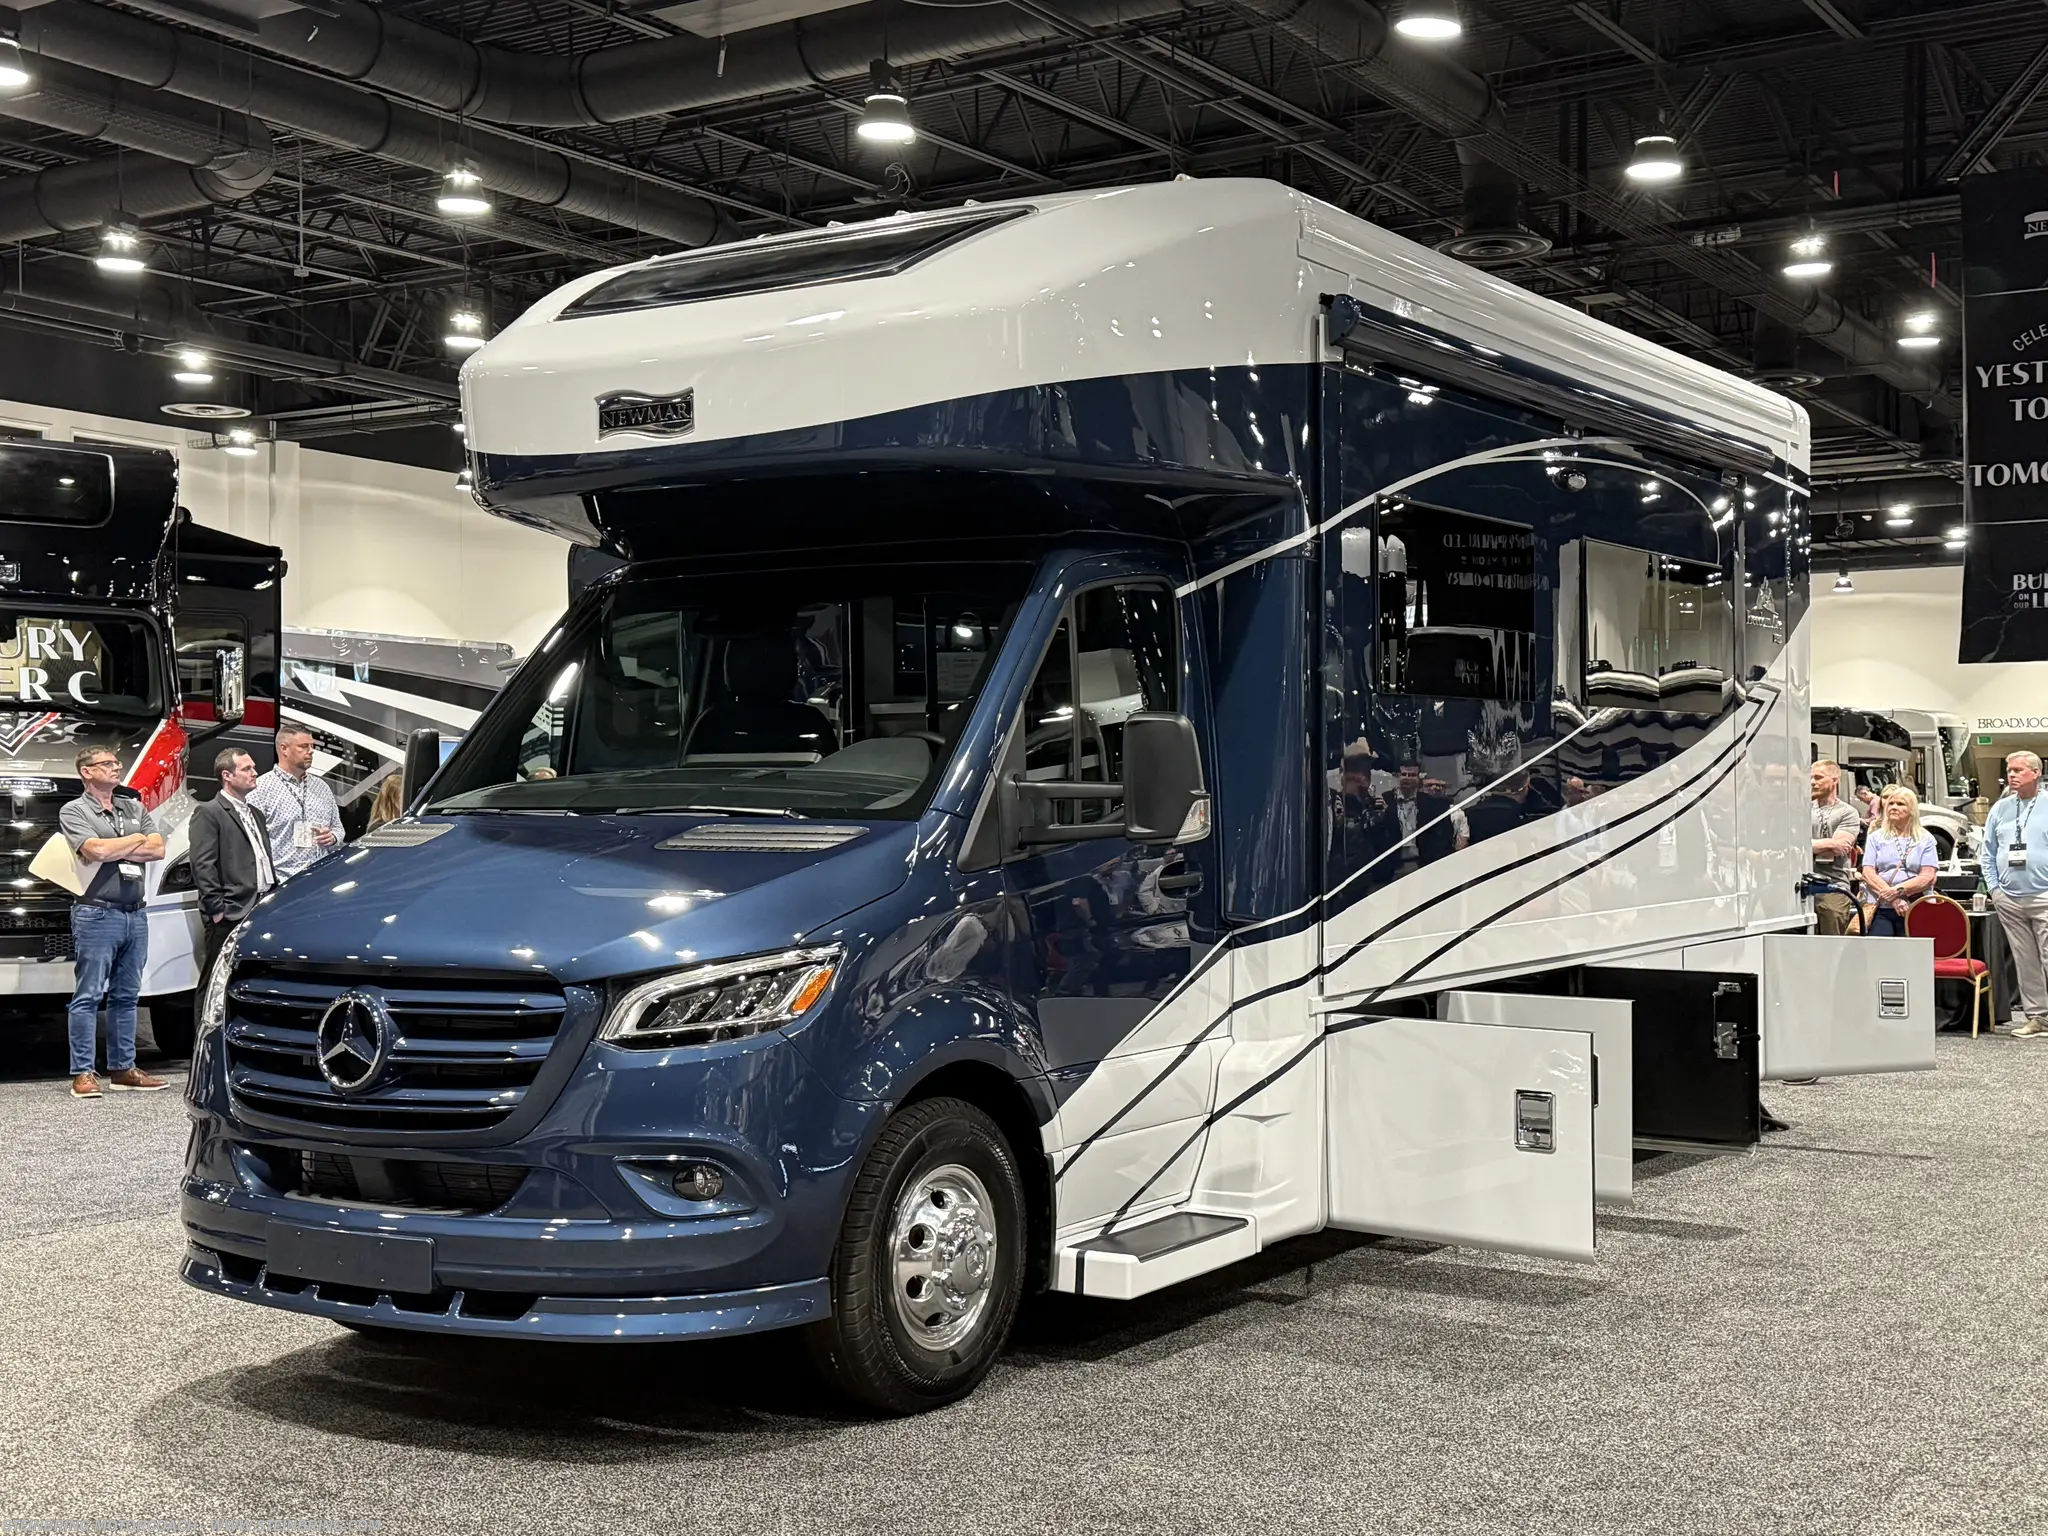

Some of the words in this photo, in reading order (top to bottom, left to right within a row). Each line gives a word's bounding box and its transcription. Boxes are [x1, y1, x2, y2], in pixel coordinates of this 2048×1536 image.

[1975, 360, 2048, 388] YEST
[601, 402, 690, 428] NEWMAR
[2009, 397, 2048, 421] TO
[2018, 593, 2030, 601] ON
[68, 670, 99, 704] C
